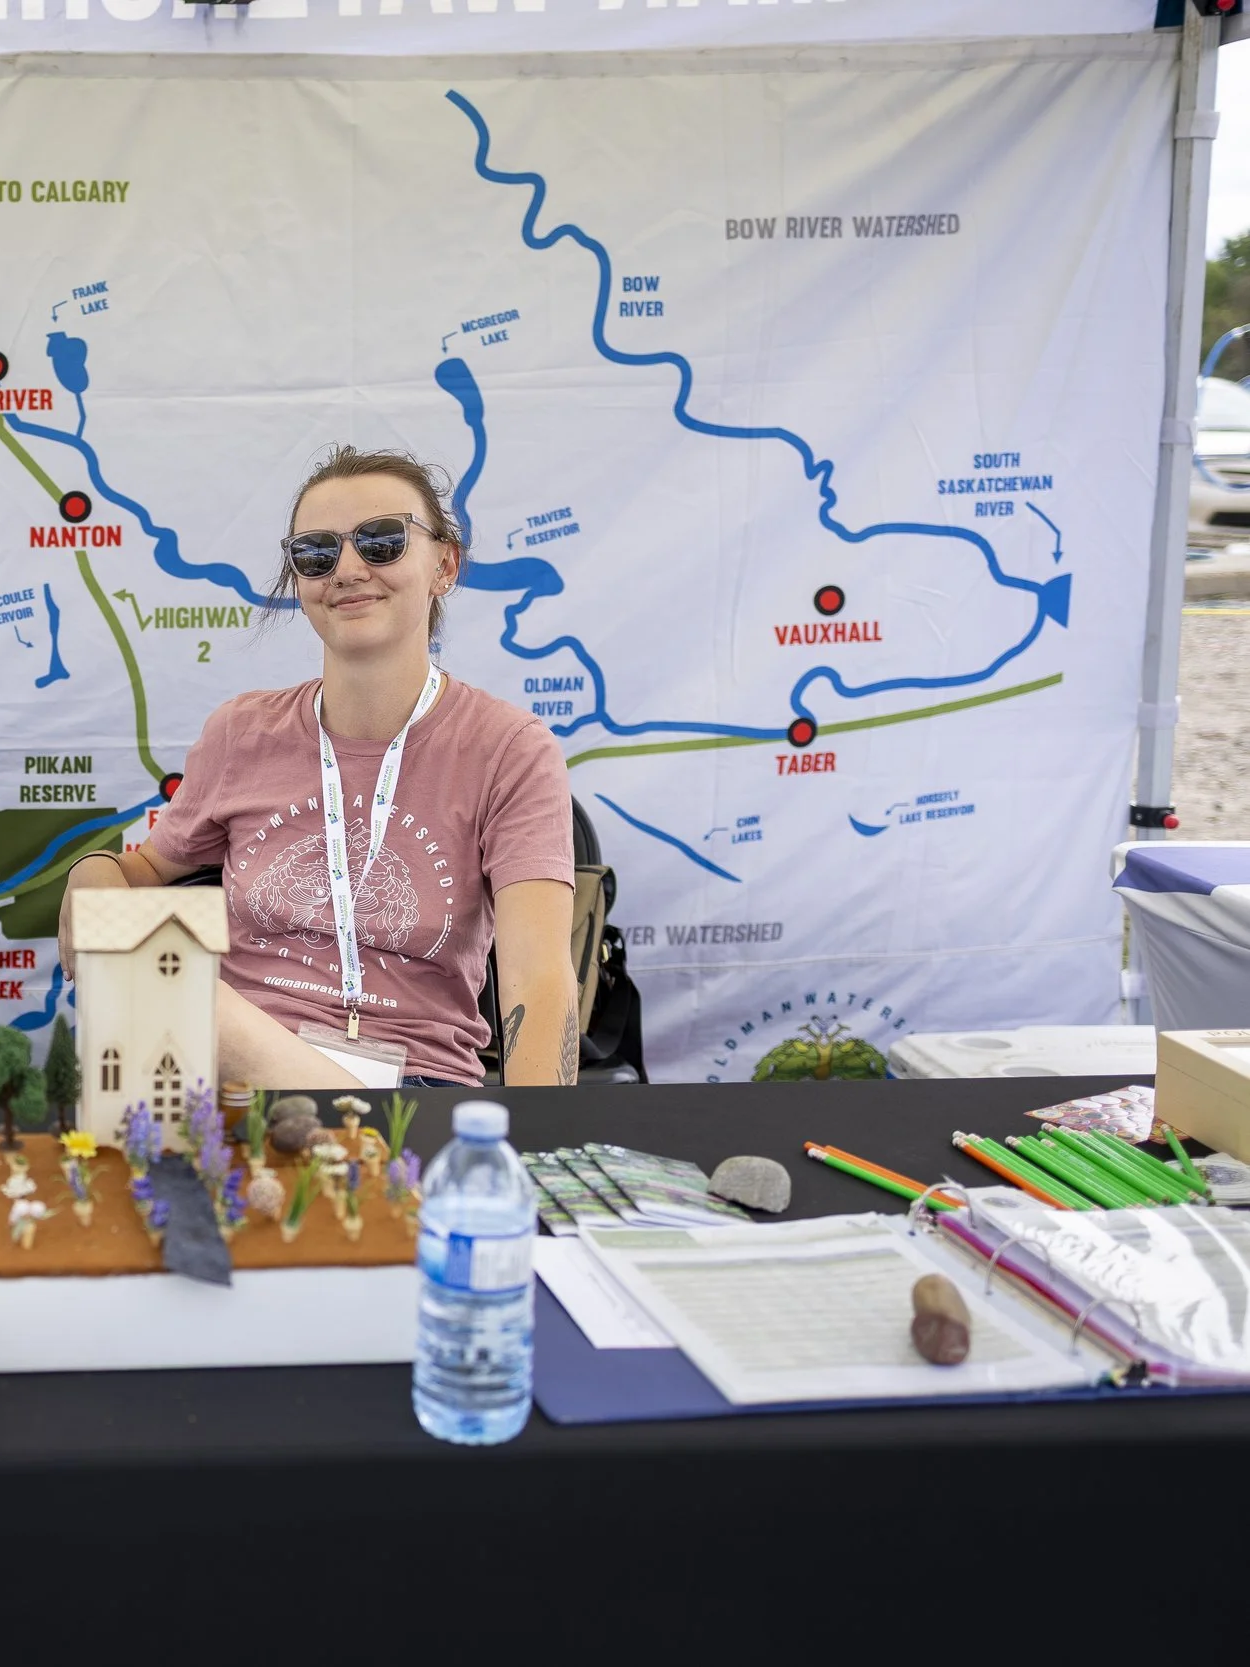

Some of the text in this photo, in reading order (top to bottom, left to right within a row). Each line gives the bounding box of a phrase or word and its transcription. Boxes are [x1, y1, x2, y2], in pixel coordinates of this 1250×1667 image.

[31, 180, 130, 203] CALGARY
[725, 213, 960, 241] BOW RIVER WATERSHED
[72, 280, 109, 300] FRANK
[622, 276, 660, 293] BOW
[80, 298, 109, 316] LAKE
[619, 300, 664, 318] RIVER
[461, 308, 520, 334] MCGREGOR
[481, 328, 510, 347] LAKE
[973, 452, 1020, 469] SOUTH
[937, 475, 1053, 495] SASKATCHEWAN
[525, 506, 573, 529] TRAVERS
[975, 500, 1014, 517] RIVER
[29, 525, 122, 548] NANTON
[525, 522, 581, 547] RESERVOIR
[154, 606, 253, 629] HIGHWAY
[774, 621, 883, 647] VAUXHALL
[197, 641, 211, 663] 2
[524, 676, 584, 694] OLDMAN
[532, 700, 573, 717] RIVER
[24, 756, 93, 775] PIIKANI
[775, 752, 836, 776] TABER
[20, 784, 96, 803] RESERVE
[732, 828, 763, 844] LAKES
[665, 922, 783, 946] WATERSHED
[804, 991, 910, 1032] WATERS
